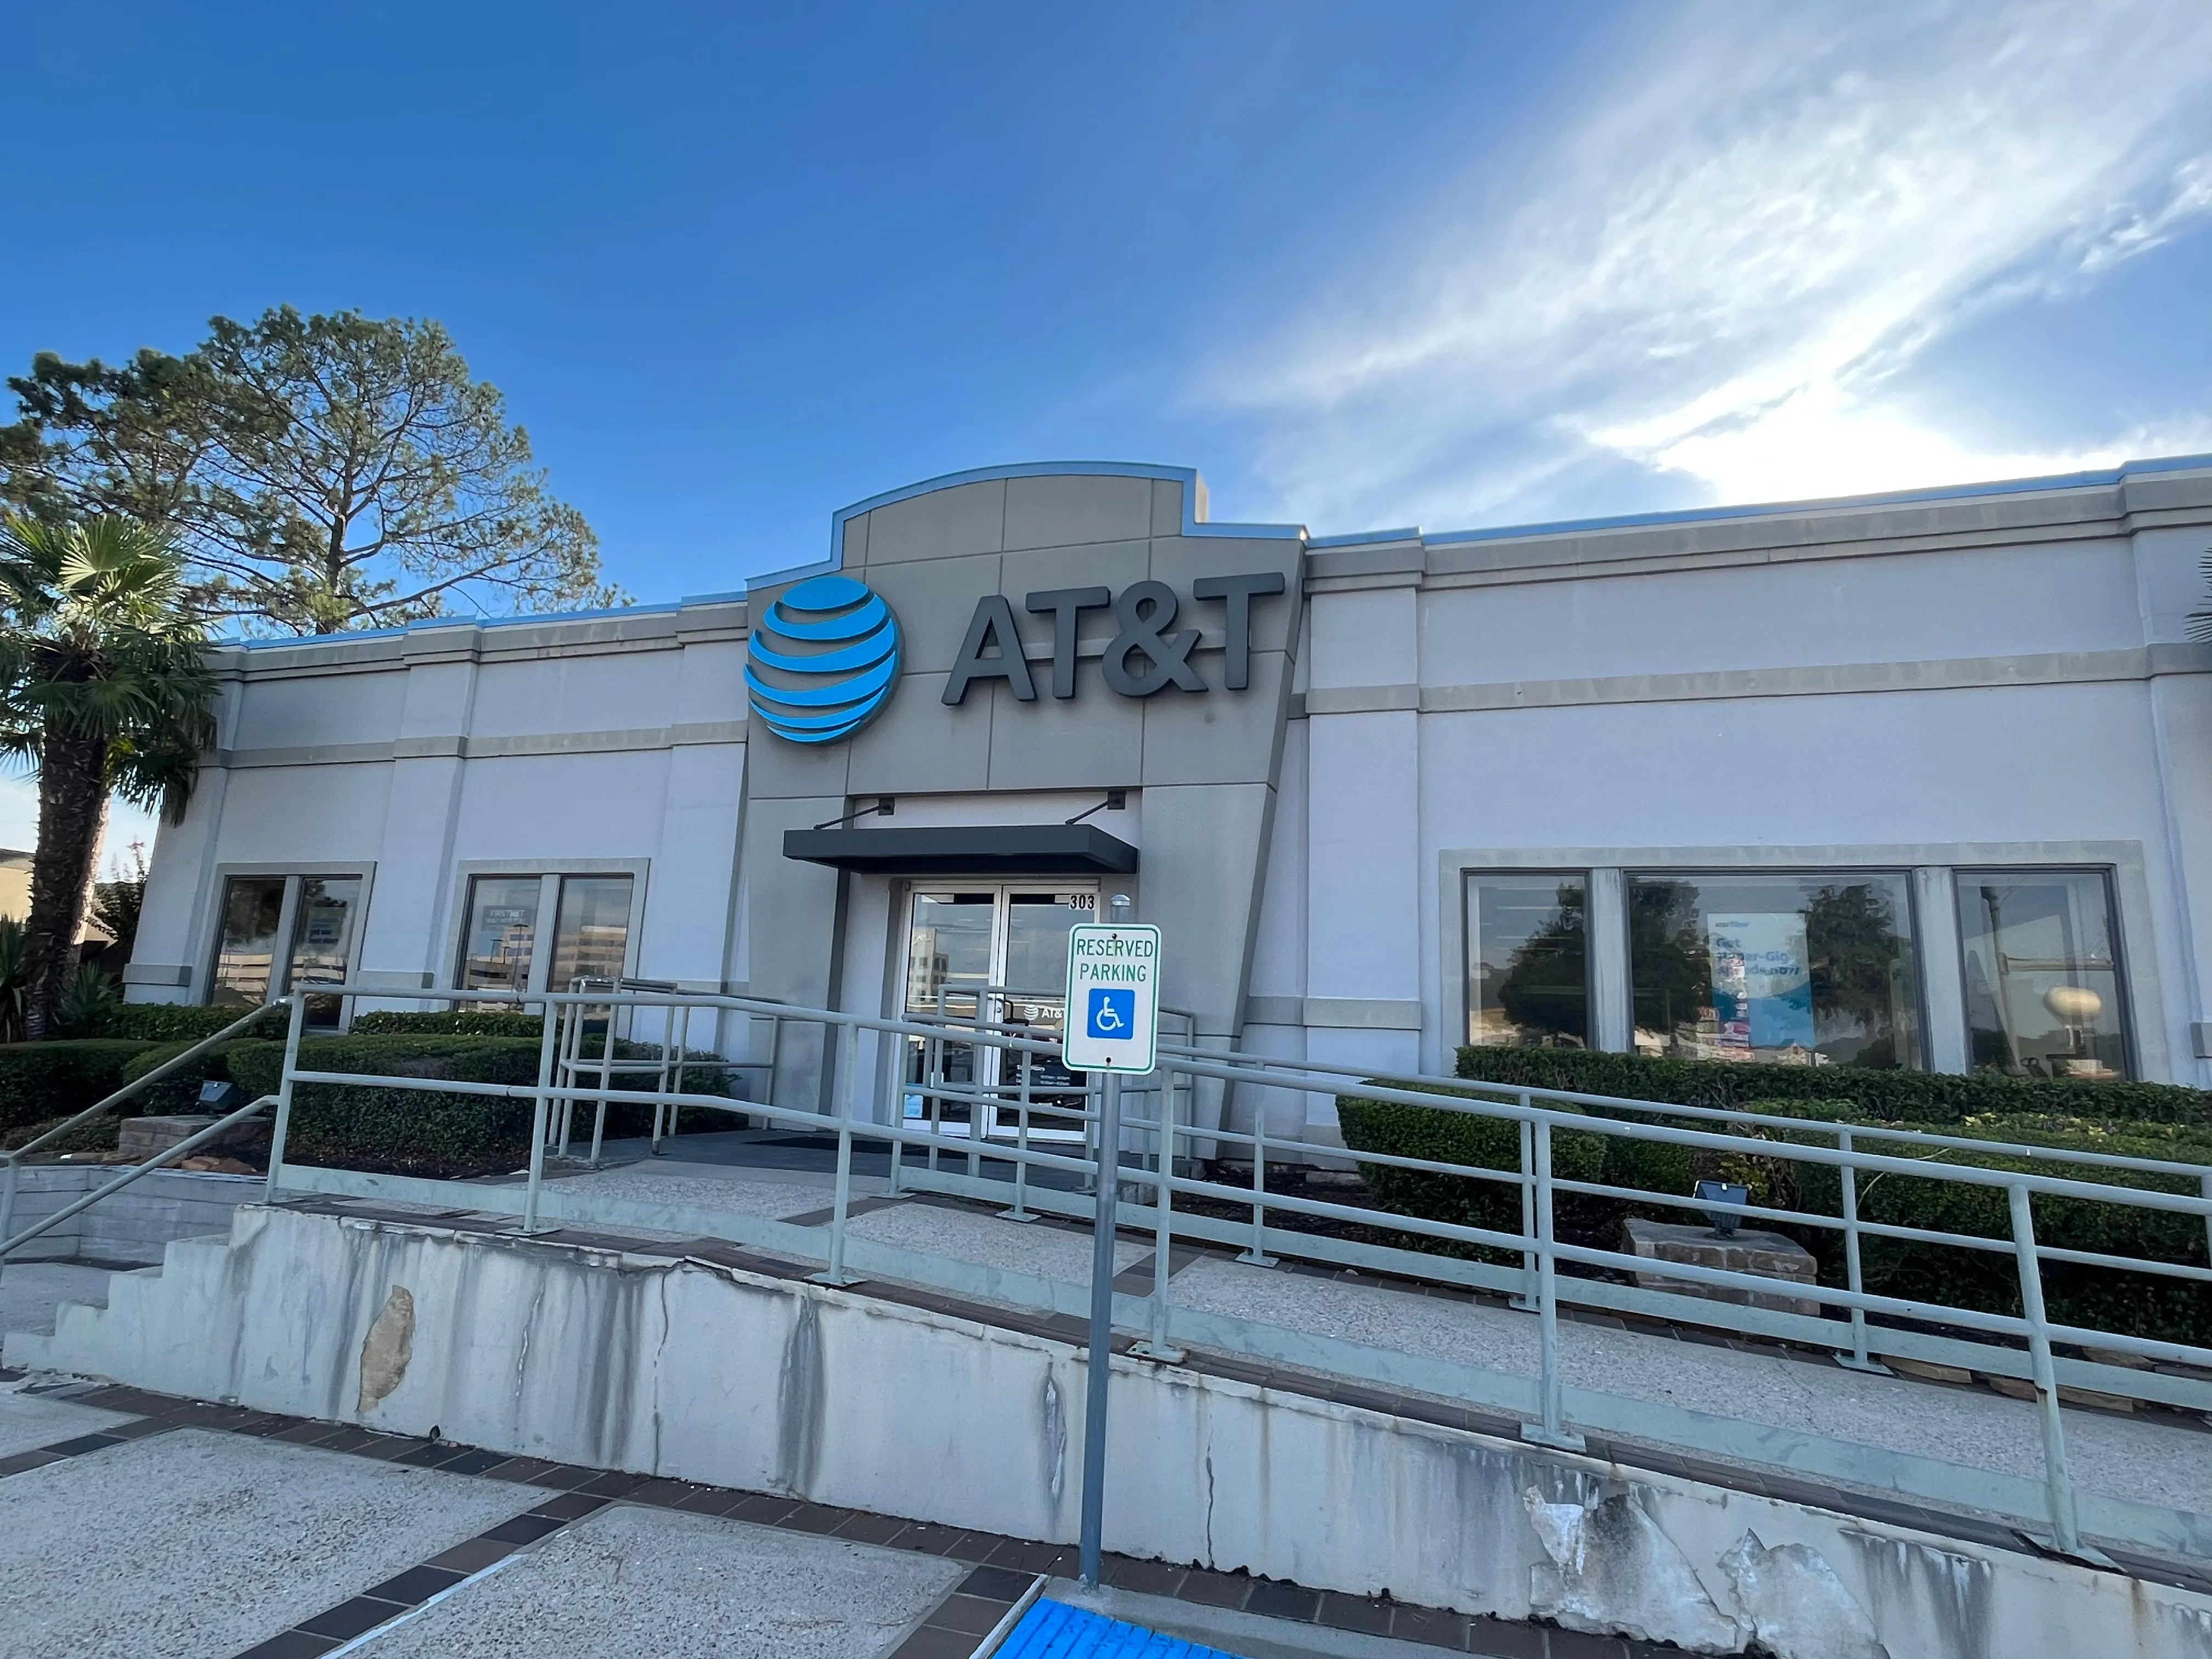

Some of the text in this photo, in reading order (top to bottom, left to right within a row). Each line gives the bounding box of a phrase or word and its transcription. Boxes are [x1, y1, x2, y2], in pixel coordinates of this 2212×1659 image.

[941, 572, 1285, 706] AT&T
[1070, 895, 1094, 909] 303
[1076, 939, 1153, 957] RESERVED
[1080, 963, 1147, 981] PARKING
[1041, 1008, 1064, 1018] AT&
